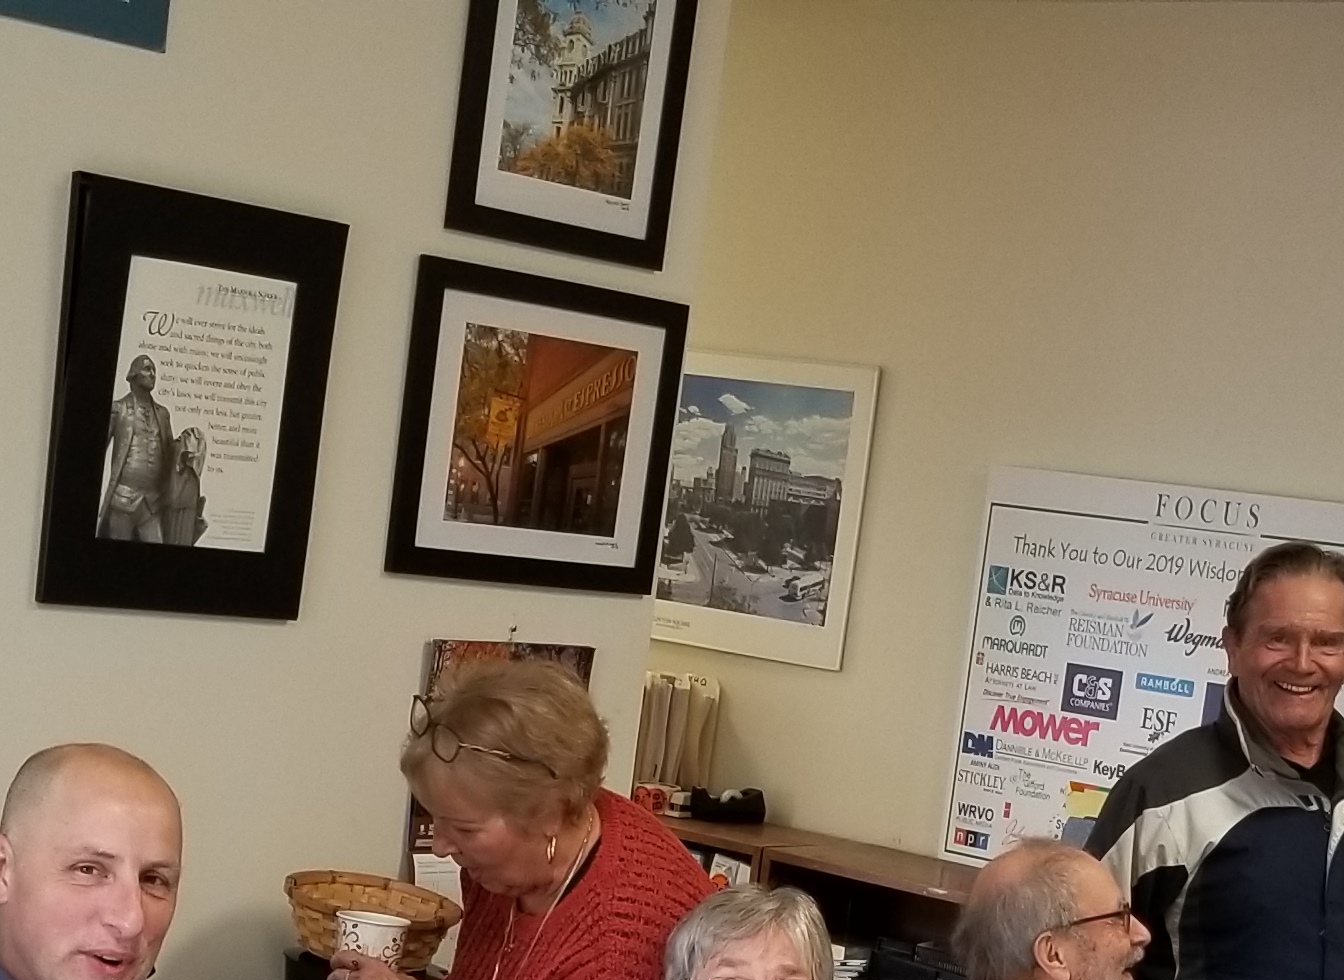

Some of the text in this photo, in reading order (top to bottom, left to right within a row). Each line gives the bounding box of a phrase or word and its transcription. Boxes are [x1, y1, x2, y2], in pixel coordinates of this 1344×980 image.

[1155, 493, 1260, 529] FOCUS
[1150, 531, 1197, 546] GREATER
[1014, 534, 1056, 559] Thank
[1060, 541, 1088, 563] You
[1093, 546, 1108, 565] to
[1112, 550, 1142, 570] Our
[1145, 554, 1184, 576] 2019
[1010, 568, 1066, 595] KS&R
[985, 599, 992, 608] &
[995, 598, 1012, 610] Rita
[1027, 603, 1062, 617] Reicher
[1088, 583, 1196, 614] Syracuse University
[1068, 618, 1123, 638] REISMAN
[1165, 618, 1226, 656] Wegma
[982, 636, 1048, 659] MARQUARDT
[1066, 633, 1148, 658] FOUNDATION
[986, 662, 1018, 679] HARRIS
[1021, 667, 1052, 684] BEACH
[1072, 673, 1113, 701] C&S
[1069, 698, 1110, 712] COMPANIES
[1140, 707, 1177, 733] ESF
[958, 769, 1005, 790] STICKLEY
[1018, 768, 1031, 779] The
[1093, 759, 1125, 780] KeyB
[1015, 787, 1050, 800] Foundation
[957, 802, 994, 822] WRVO
